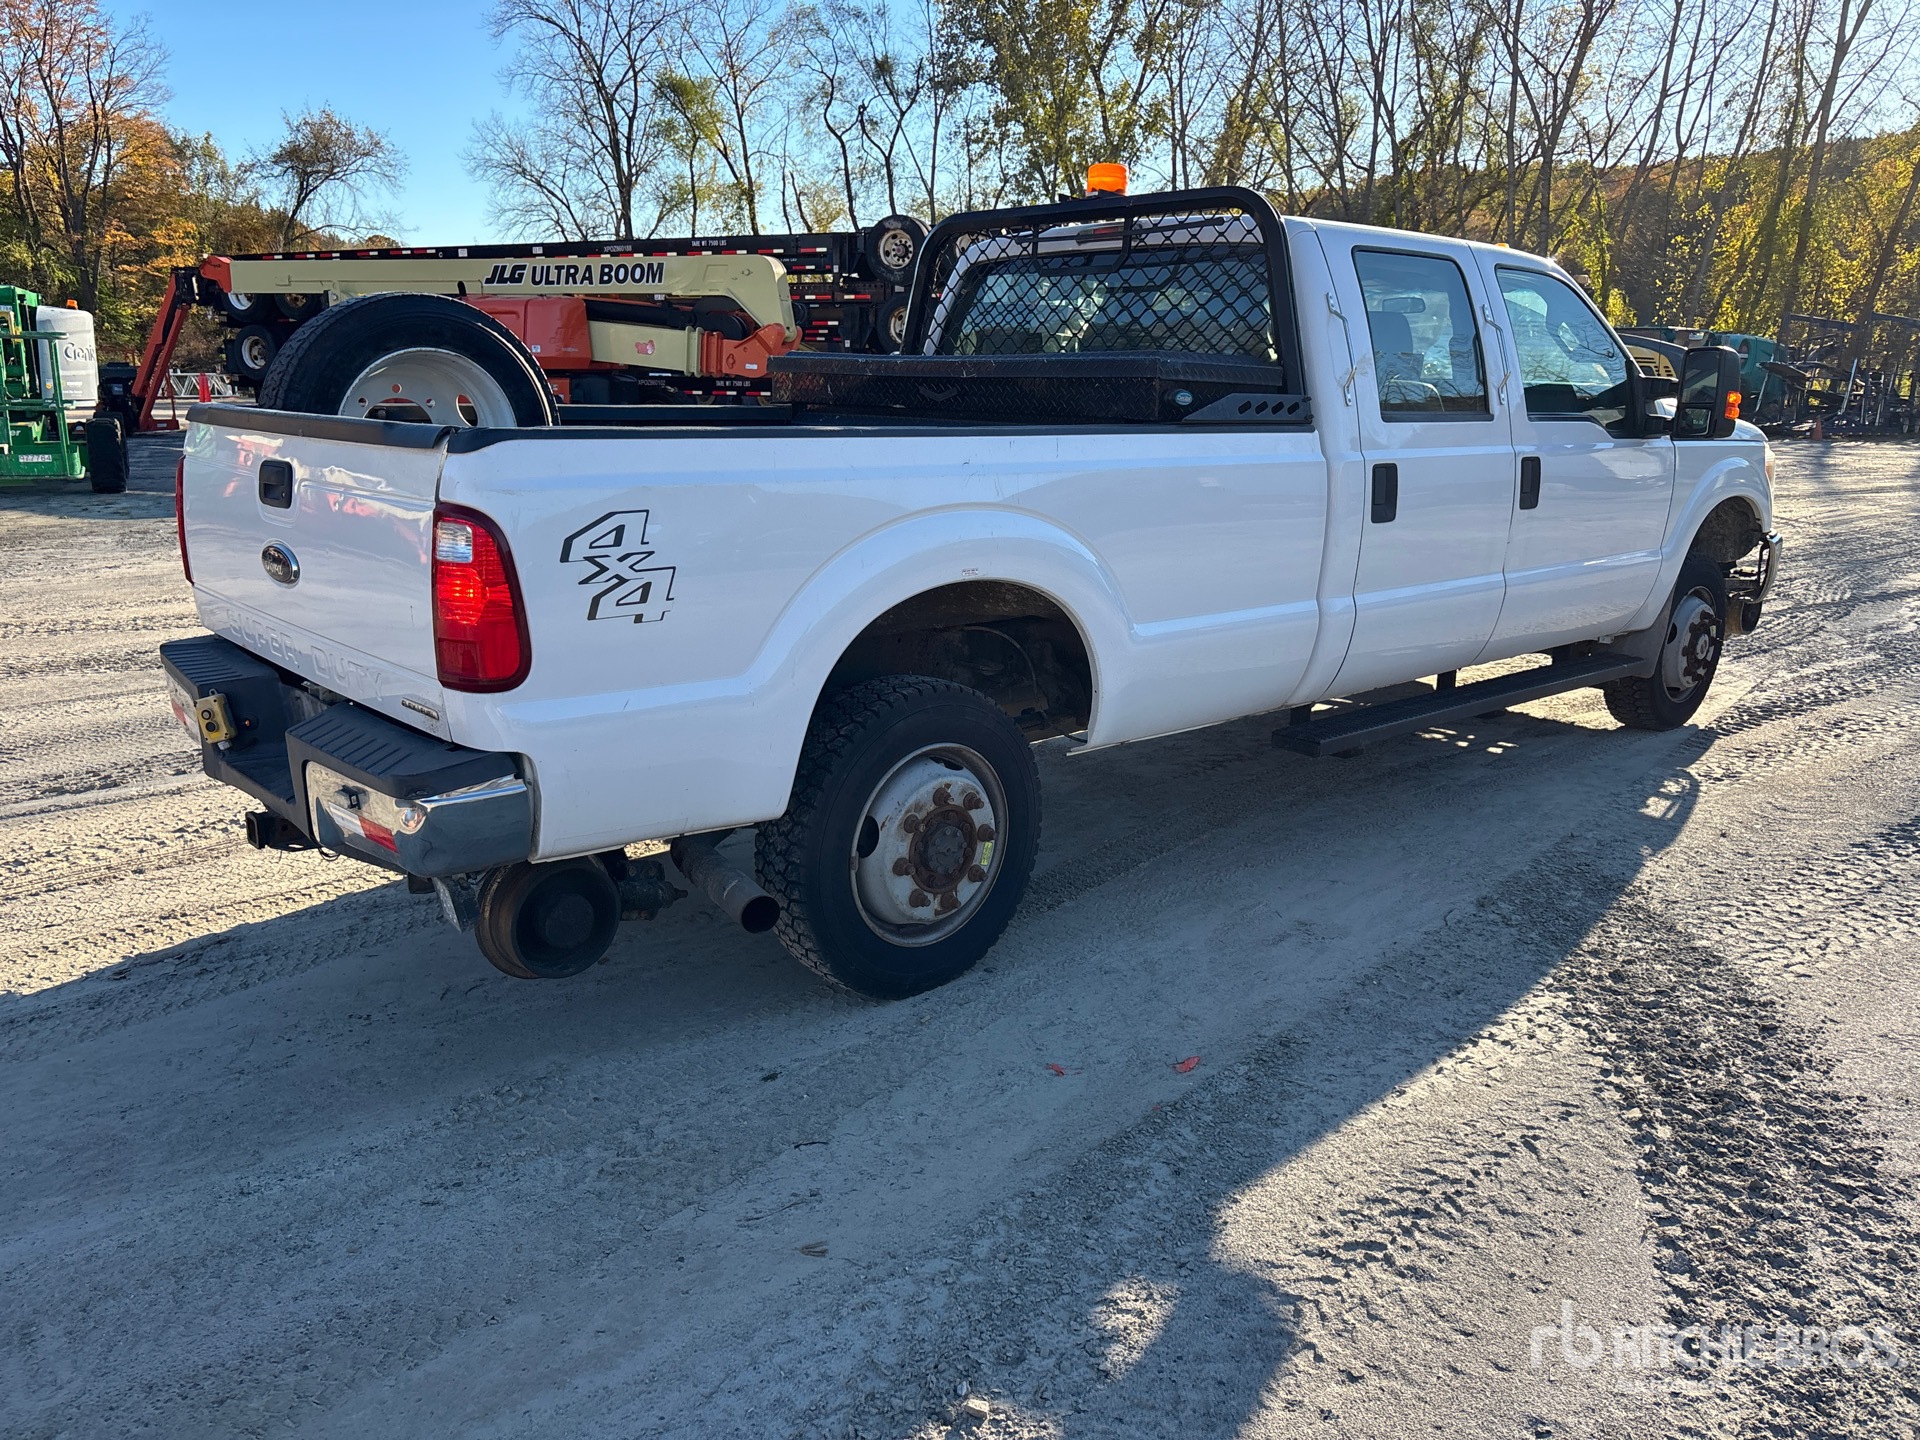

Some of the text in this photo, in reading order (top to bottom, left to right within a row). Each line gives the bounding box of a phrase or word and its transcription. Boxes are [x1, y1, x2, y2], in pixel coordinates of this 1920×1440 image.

[484, 262, 664, 285] JLG ULTRA BOOM
[226, 608, 384, 702] SUPER DUTY
